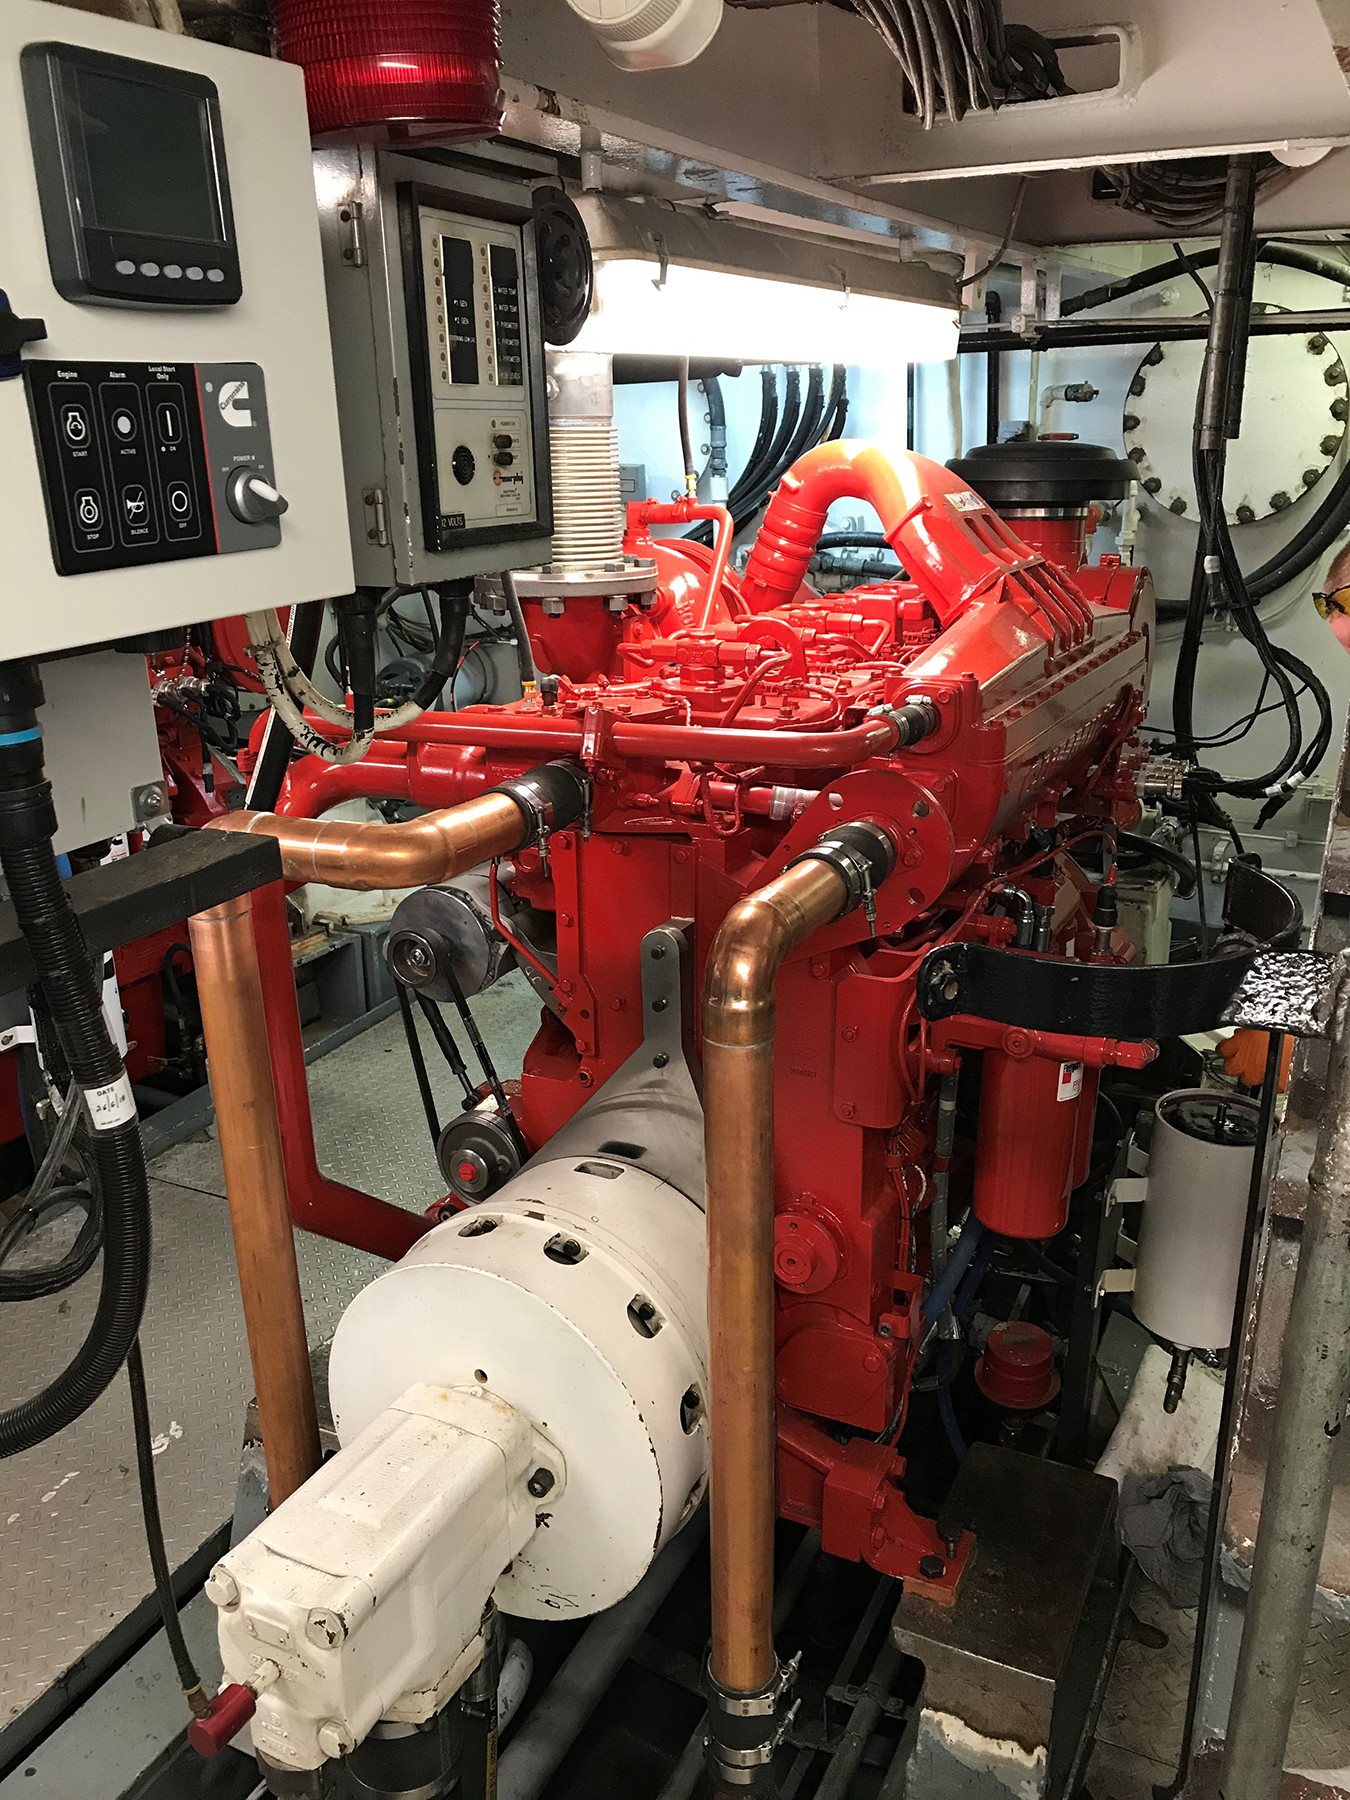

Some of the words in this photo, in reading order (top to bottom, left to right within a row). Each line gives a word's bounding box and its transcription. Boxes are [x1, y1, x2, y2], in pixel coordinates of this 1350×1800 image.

[57, 370, 78, 379] Engine
[220, 382, 246, 410] Cummins
[447, 516, 464, 527] VOLTS
[97, 1086, 115, 1097] DATE
